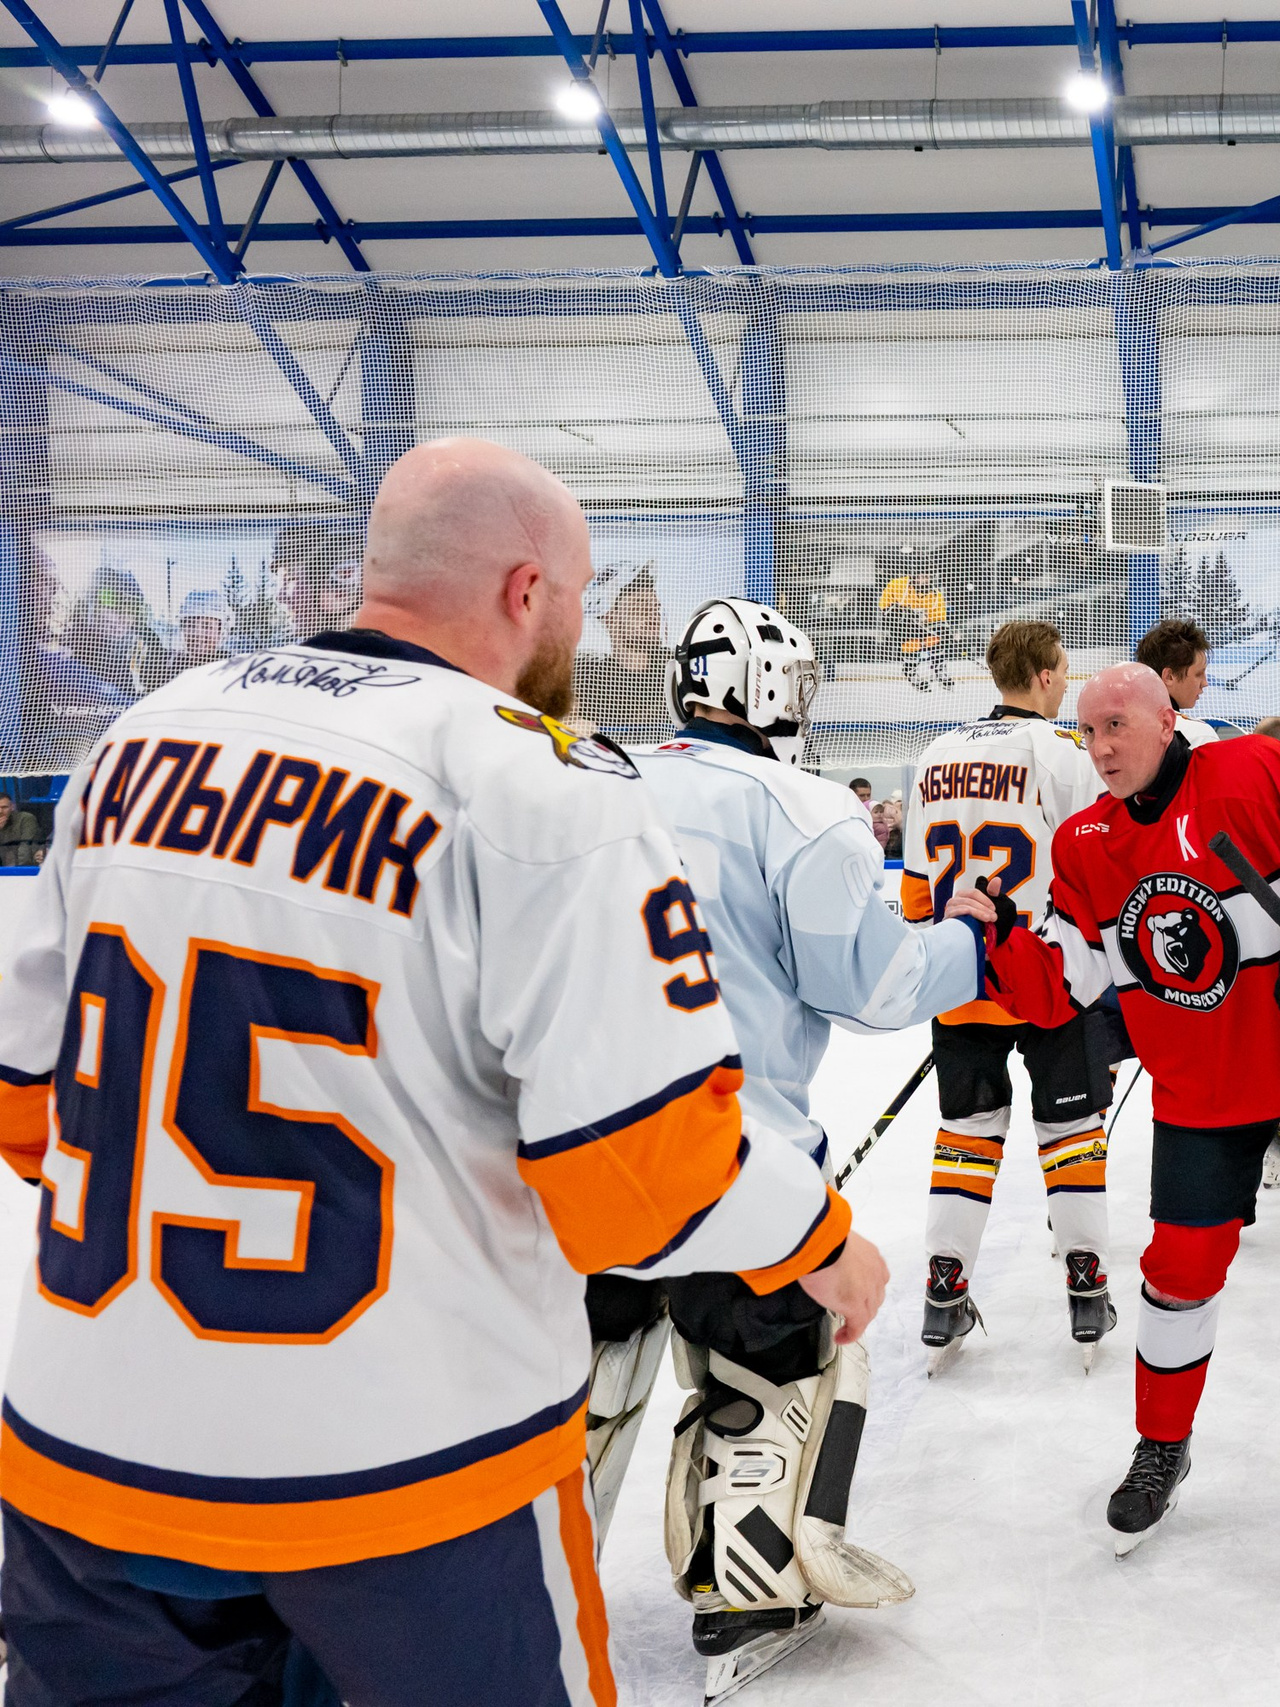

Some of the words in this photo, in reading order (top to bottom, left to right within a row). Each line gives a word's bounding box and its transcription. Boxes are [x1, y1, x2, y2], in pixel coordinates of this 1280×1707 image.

[690, 655, 709, 676] 31
[755, 656, 763, 710] BAUER
[1121, 880, 1154, 939] HOCKY
[1156, 877, 1224, 922] EDITION
[640, 875, 721, 1013] 9
[1164, 978, 1226, 1008] MOSCOW
[1056, 1093, 1088, 1105] BAUER
[36, 921, 396, 1345] 95
